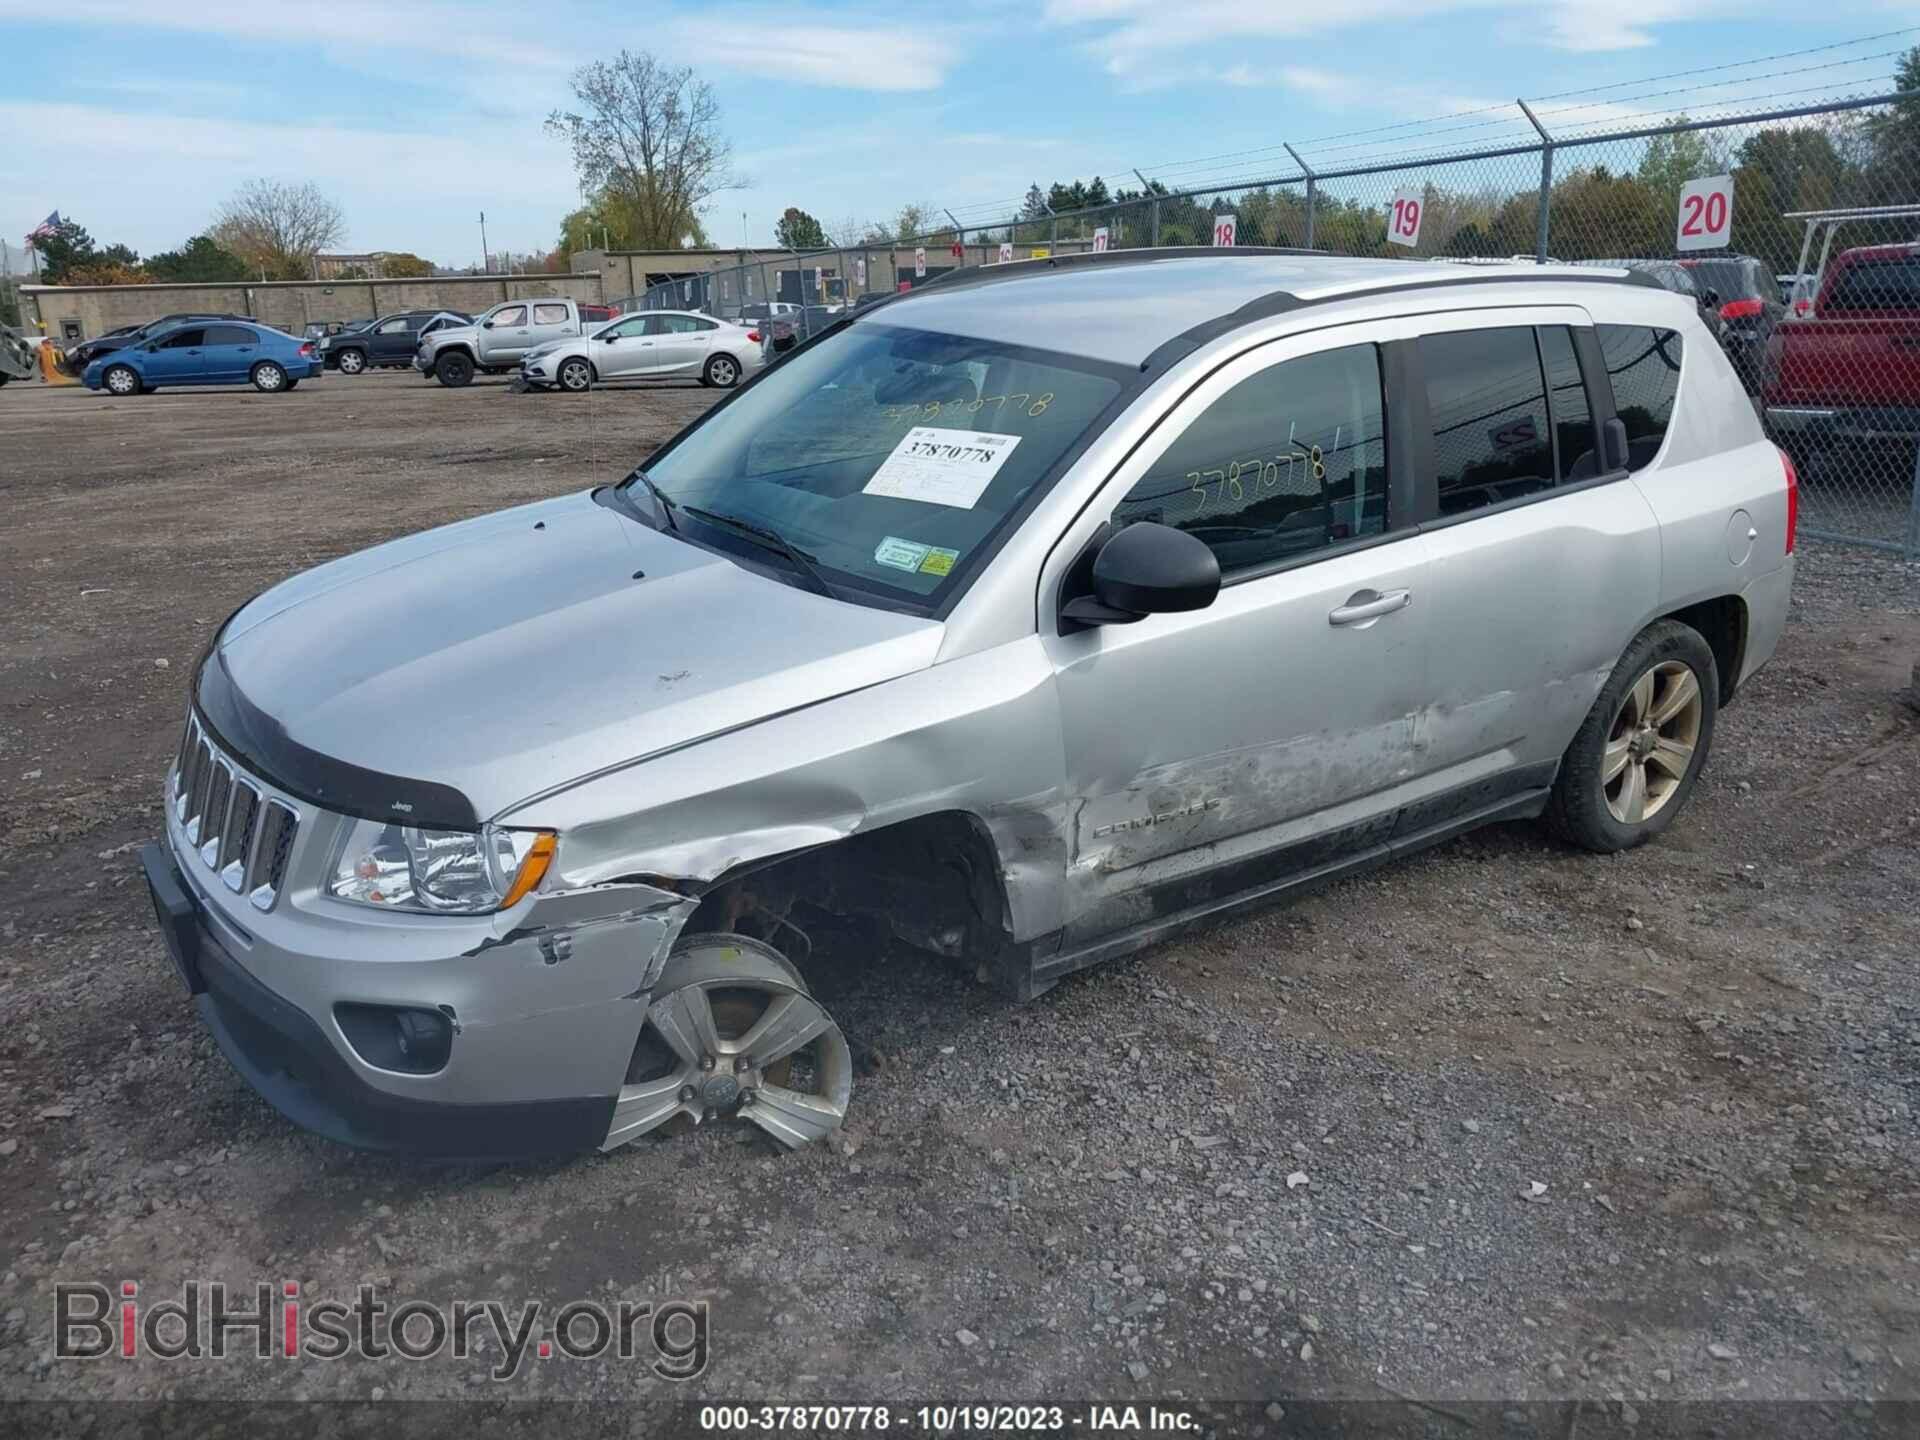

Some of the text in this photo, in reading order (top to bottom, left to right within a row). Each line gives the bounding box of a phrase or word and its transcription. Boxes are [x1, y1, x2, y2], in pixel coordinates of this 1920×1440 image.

[1394, 199, 1420, 236] 19
[1681, 192, 1727, 236] 20
[1096, 234, 1106, 251] 17
[1216, 224, 1233, 247] 18
[916, 252, 925, 273] 15
[881, 392, 1054, 423] 37870778
[904, 441, 996, 463] 37870778
[1187, 445, 1325, 513] 37870778
[391, 800, 413, 812] Jeep
